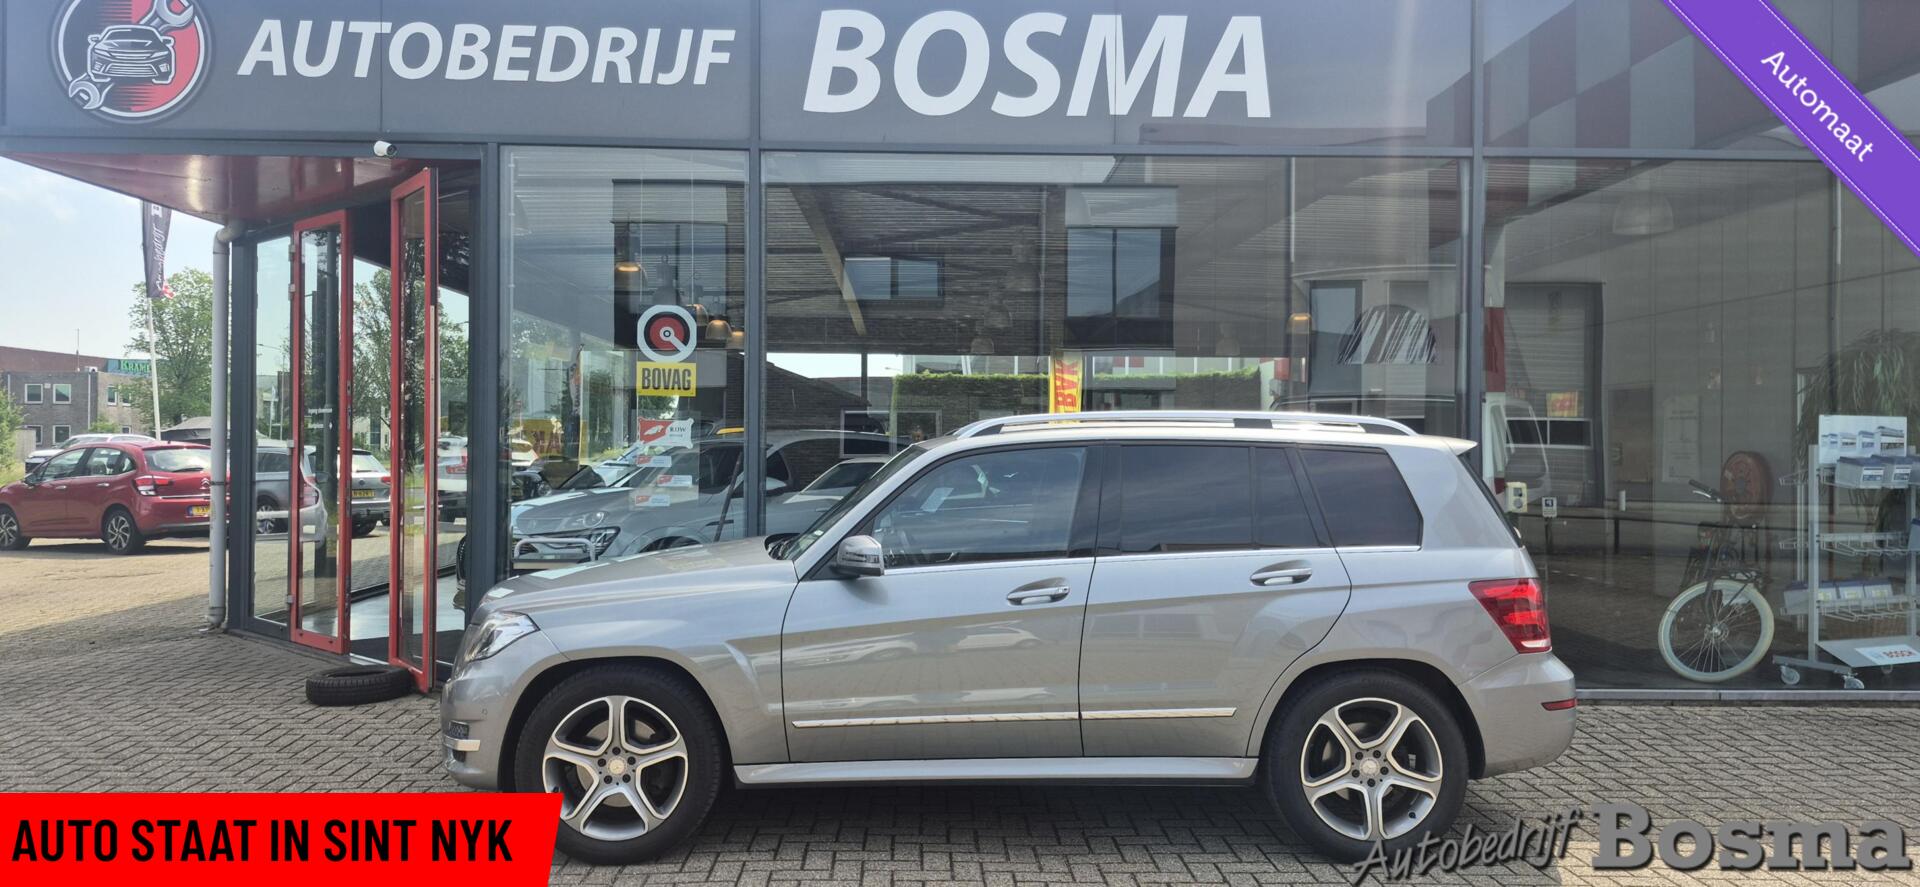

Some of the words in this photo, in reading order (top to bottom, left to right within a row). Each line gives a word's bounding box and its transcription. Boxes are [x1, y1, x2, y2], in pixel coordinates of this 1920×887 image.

[237, 19, 736, 85] AUTOBEDRIJF
[803, 9, 1271, 118] BOSMA
[641, 367, 692, 391] BOVAG
